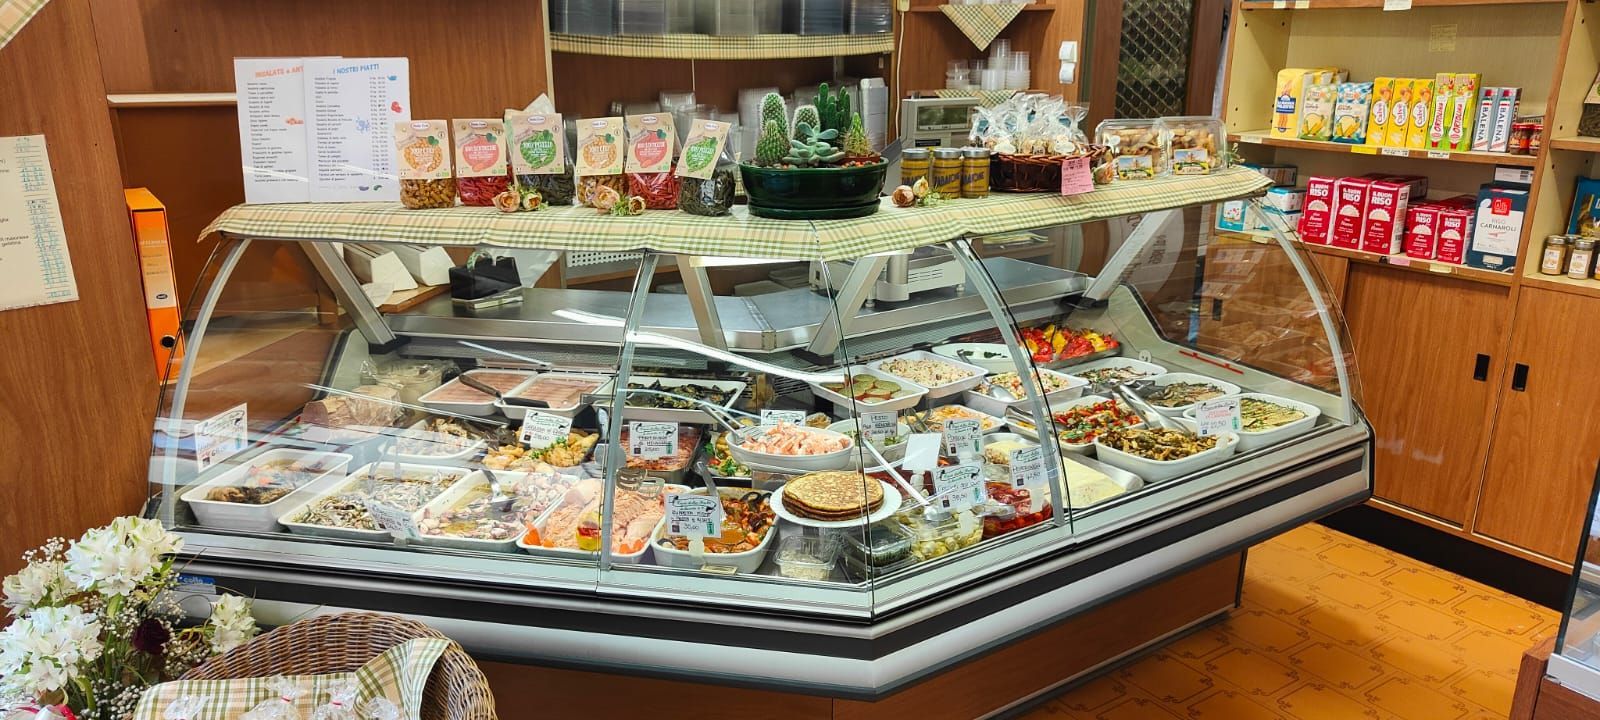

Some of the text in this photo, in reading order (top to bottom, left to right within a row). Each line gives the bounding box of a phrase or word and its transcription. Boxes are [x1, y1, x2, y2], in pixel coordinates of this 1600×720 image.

[336, 65, 359, 74] NOSTRI
[360, 63, 380, 72] PIATTI
[1478, 107, 1489, 141] BALENA
[1494, 107, 1506, 142] BALENA
[1309, 188, 1329, 197] RISO
[1342, 193, 1361, 202] RISO
[1371, 196, 1393, 205] RISO
[1480, 222, 1517, 232] CARNAROLI
